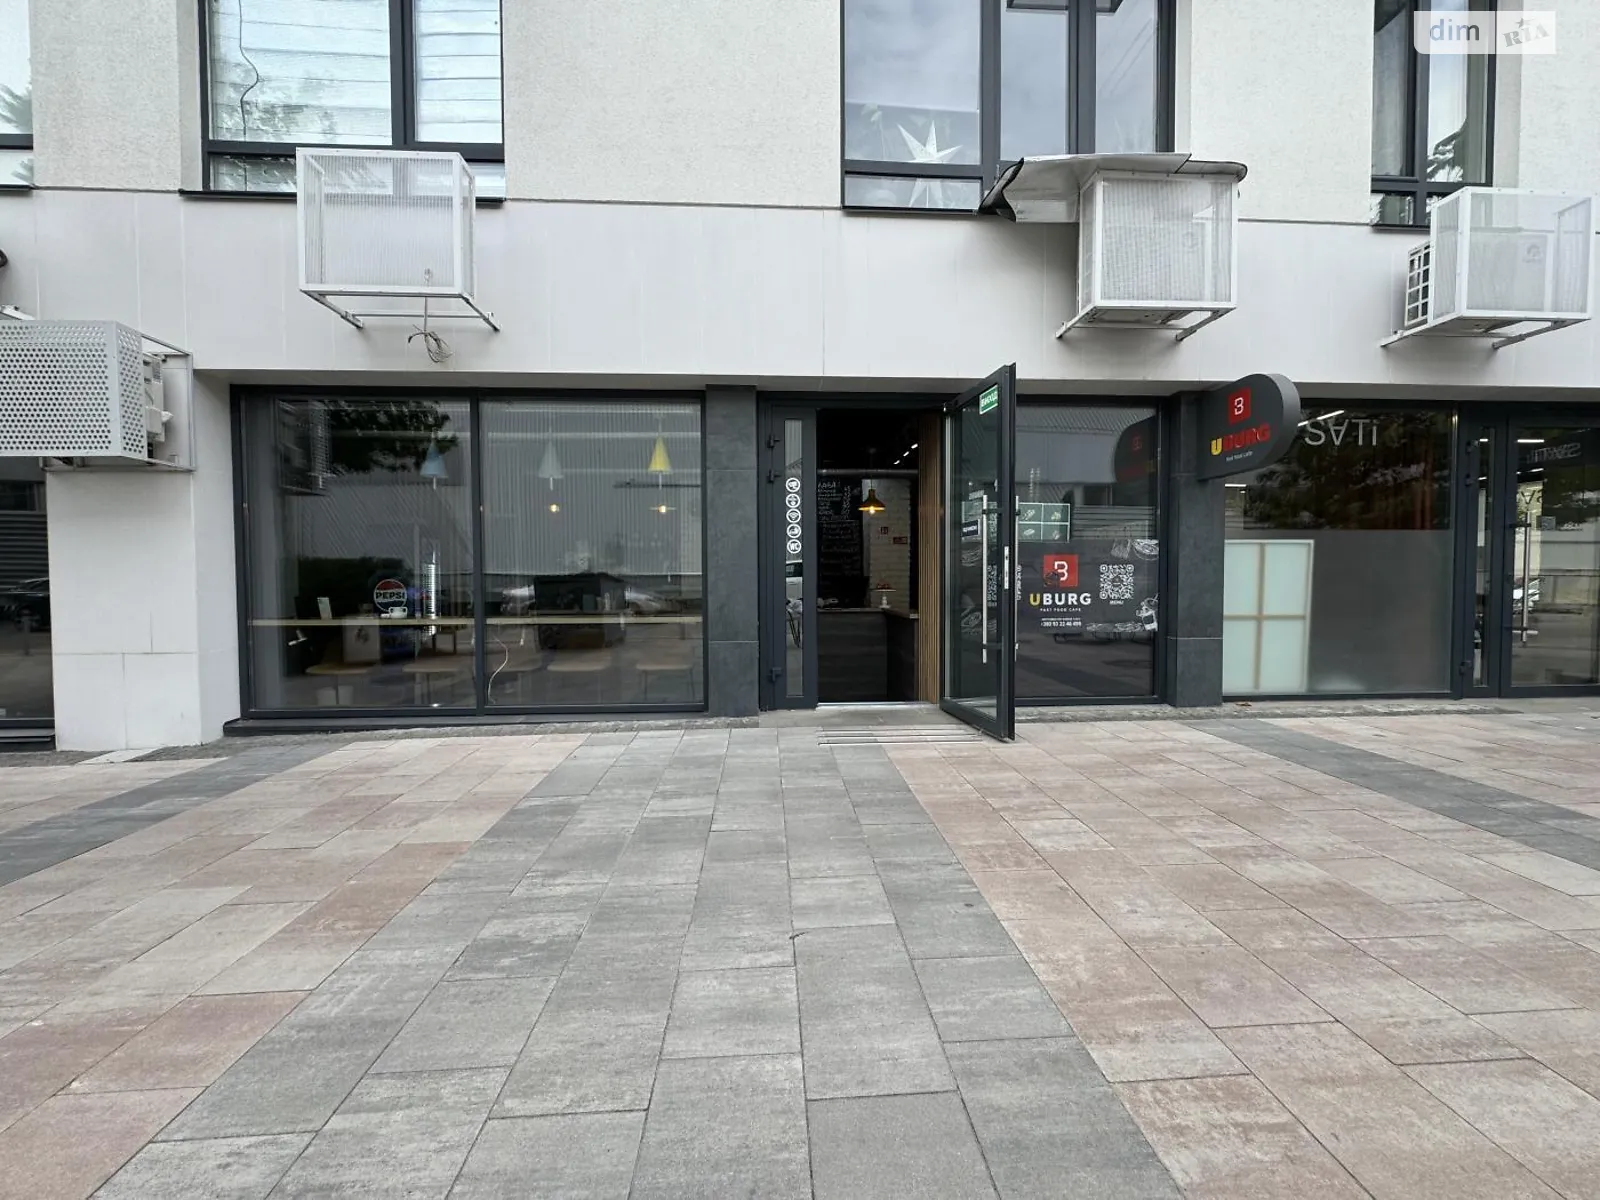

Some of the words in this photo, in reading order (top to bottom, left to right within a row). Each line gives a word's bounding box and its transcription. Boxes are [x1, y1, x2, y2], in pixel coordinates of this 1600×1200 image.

[788, 542, 800, 552] WC
[375, 592, 405, 600] PEPSI
[1029, 592, 1092, 606] UBURG
